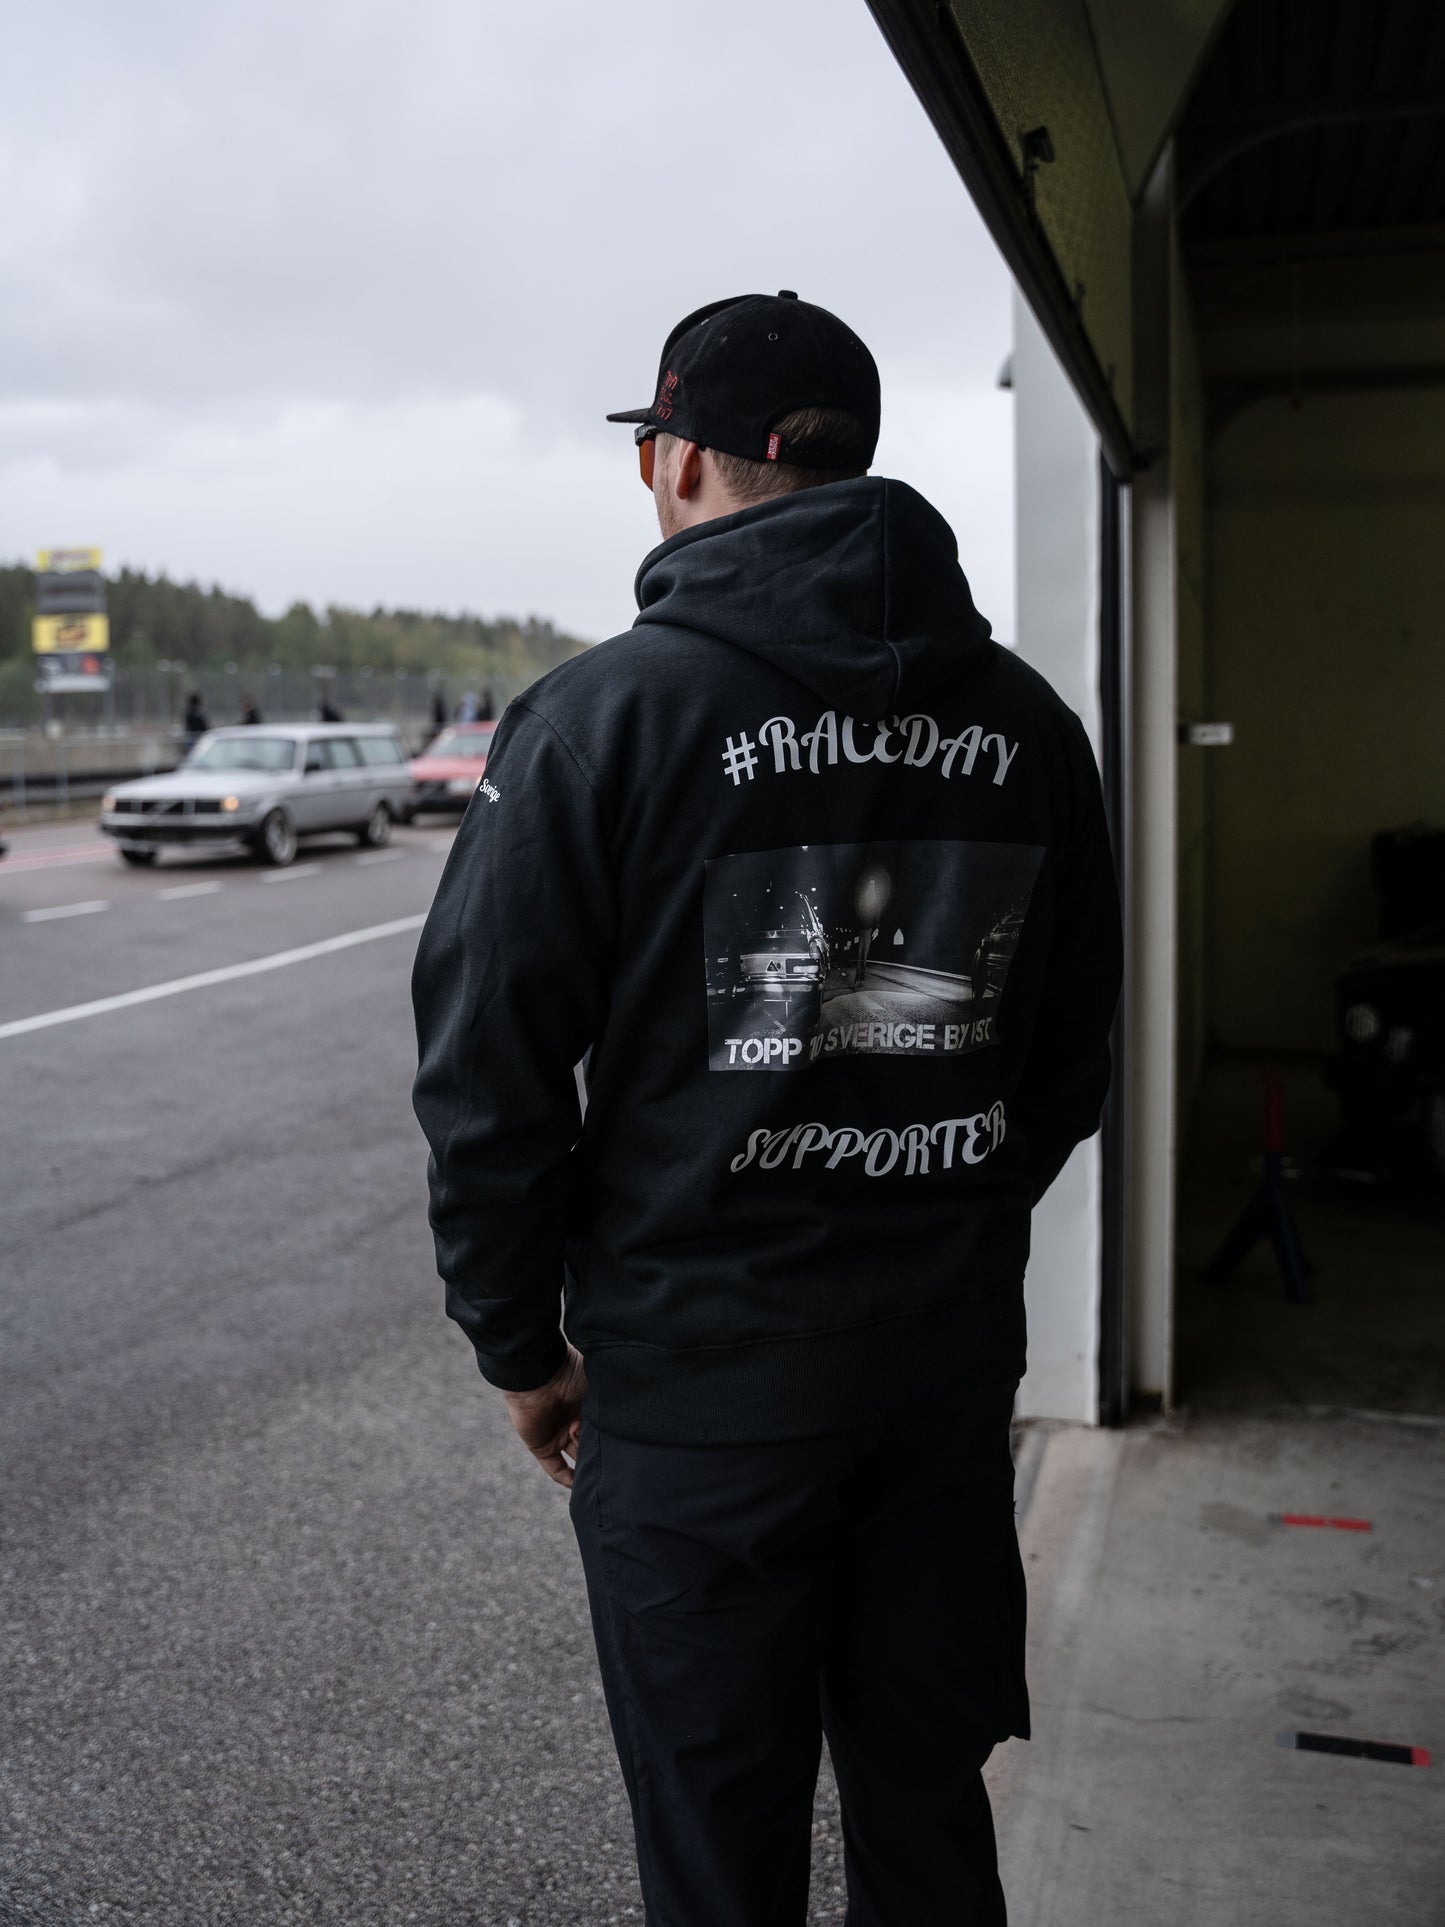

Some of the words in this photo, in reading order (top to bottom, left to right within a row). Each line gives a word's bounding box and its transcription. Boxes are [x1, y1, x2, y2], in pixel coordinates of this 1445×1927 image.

[721, 711, 1019, 786] #RACEDAY
[724, 1038, 803, 1065] TOPP
[824, 1022, 936, 1050] SVERIGE
[943, 1024, 970, 1050] BY
[730, 1100, 1006, 1177] SUPPORTER
